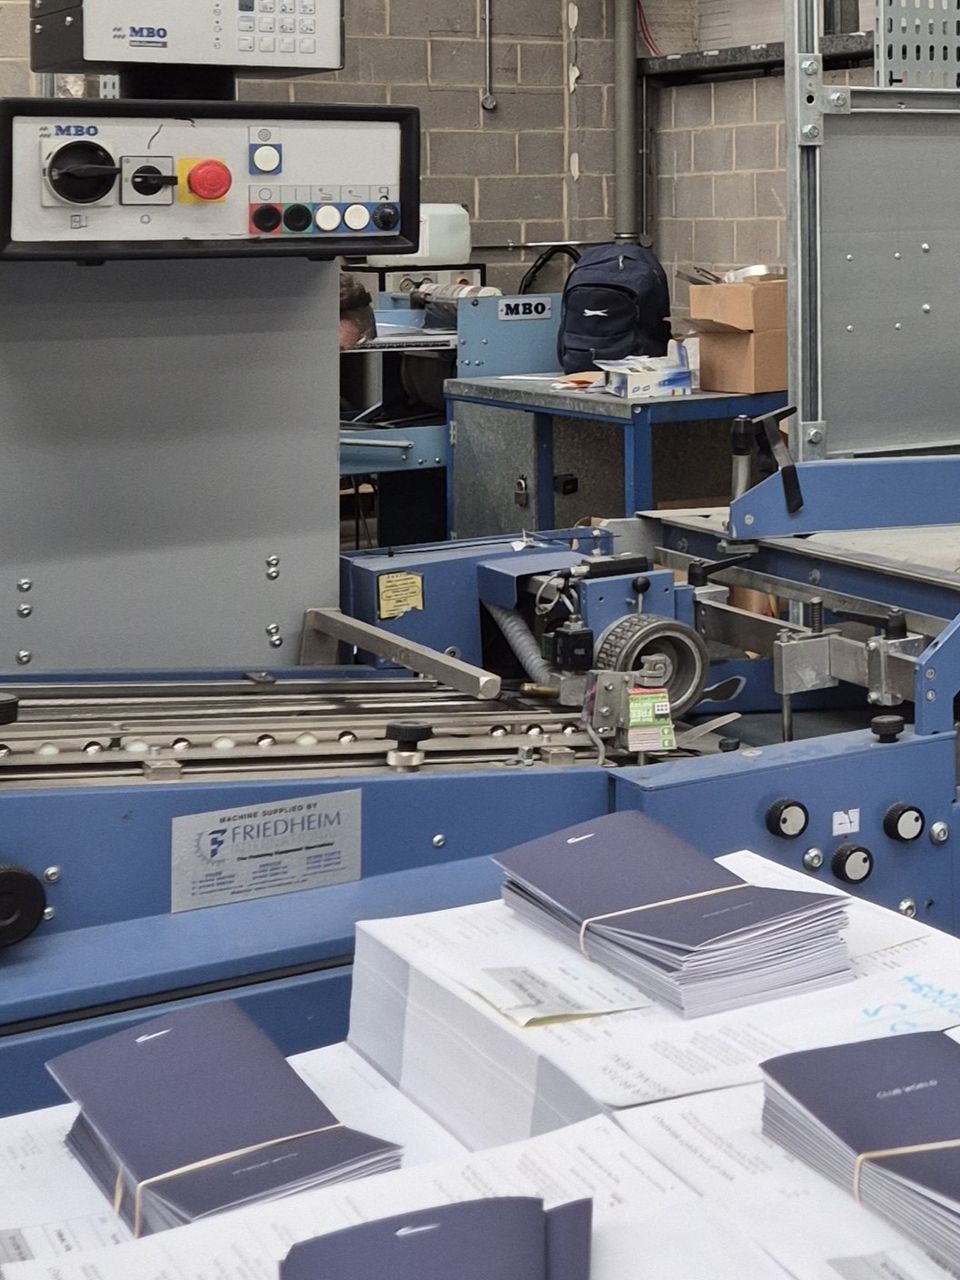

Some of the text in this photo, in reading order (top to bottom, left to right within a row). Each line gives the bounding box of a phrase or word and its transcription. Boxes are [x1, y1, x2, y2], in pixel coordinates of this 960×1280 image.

[129, 26, 168, 39] MBO
[54, 125, 99, 137] MBO
[504, 302, 546, 316] MBO
[219, 802, 318, 824] MACHINE SUPPLIED BY
[231, 811, 342, 843] FRIEDHEIM
